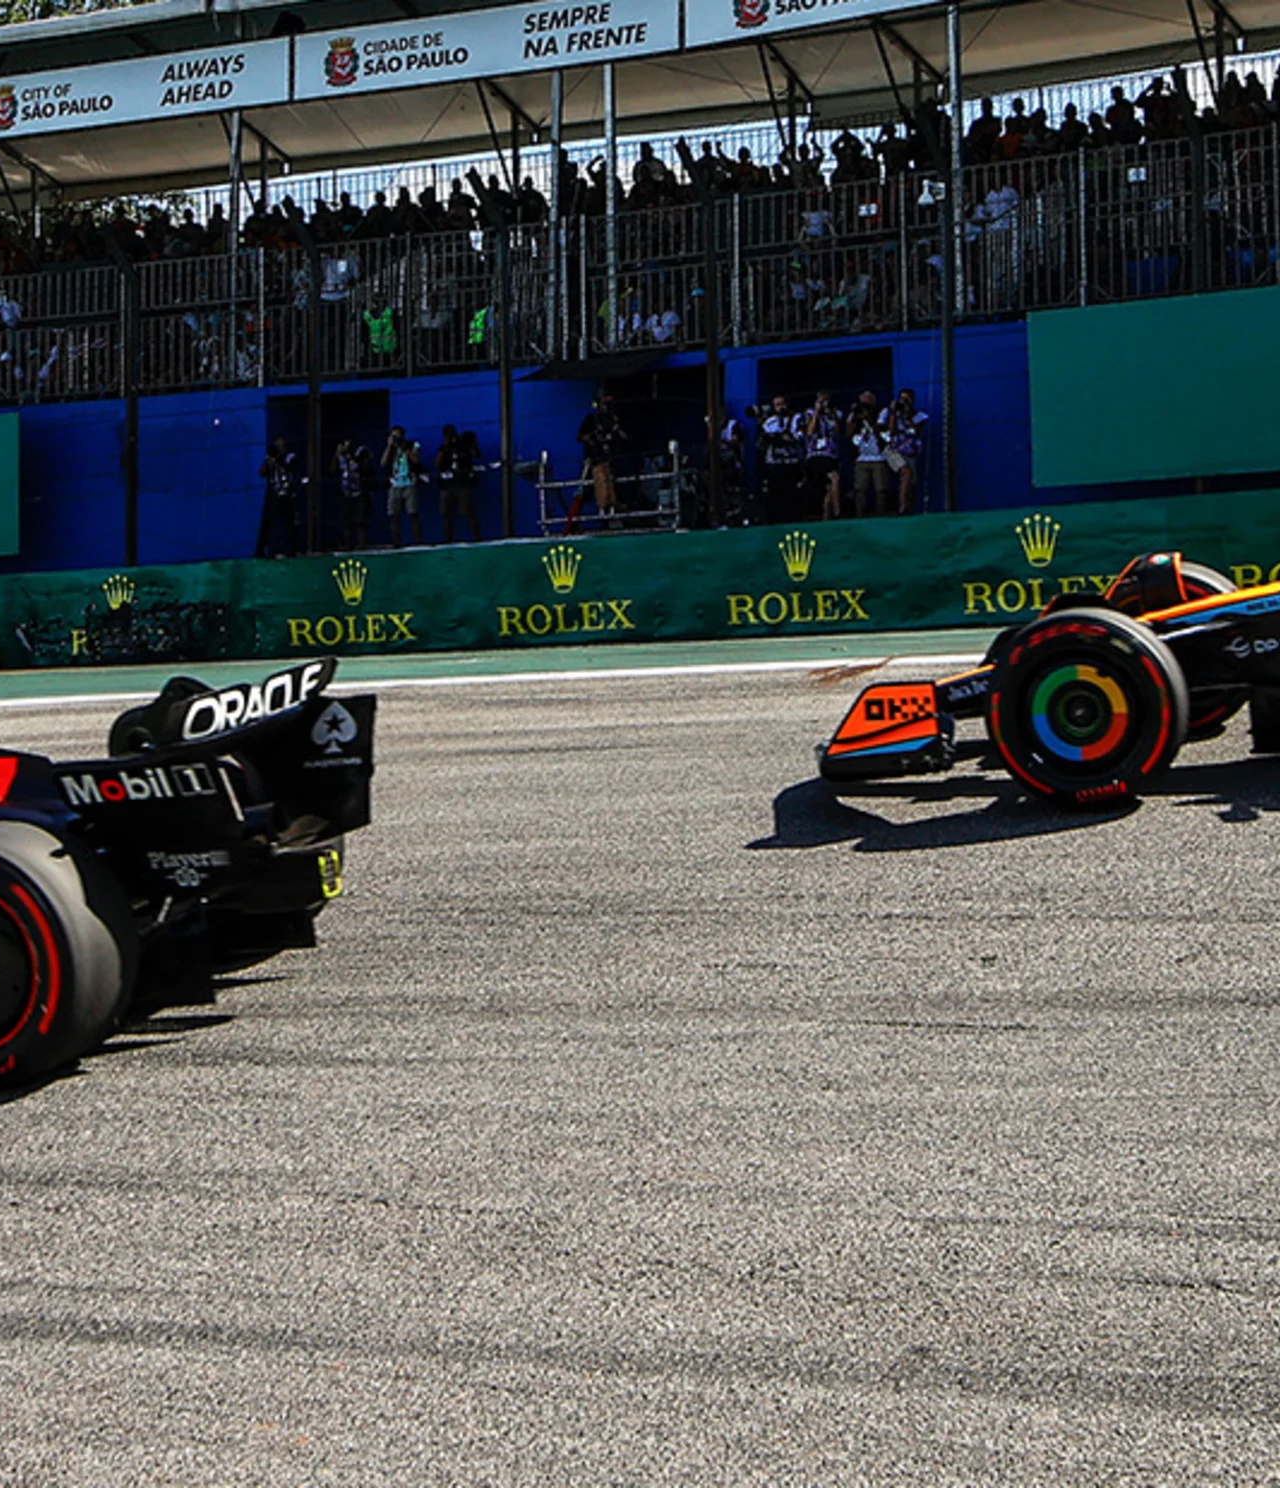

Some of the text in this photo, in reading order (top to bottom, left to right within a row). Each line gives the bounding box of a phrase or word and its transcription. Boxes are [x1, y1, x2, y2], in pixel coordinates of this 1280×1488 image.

[523, 2, 611, 34] SEMPRE
[363, 32, 444, 56] CIDADE DE
[523, 23, 649, 59] NA FRENTE
[161, 53, 246, 84] ALWAYS
[363, 47, 470, 77] SÃO PAULO
[20, 83, 73, 101] CITY OF
[160, 80, 235, 107] AHEAD
[20, 95, 114, 122] SÃO PAULO
[497, 598, 637, 637] ROLEX
[727, 588, 870, 626] ROLEX
[287, 611, 418, 648] ROLEX
[1253, 640, 1279, 654] DP
[864, 696, 932, 721] OKX
[59, 767, 175, 806] Mobil
